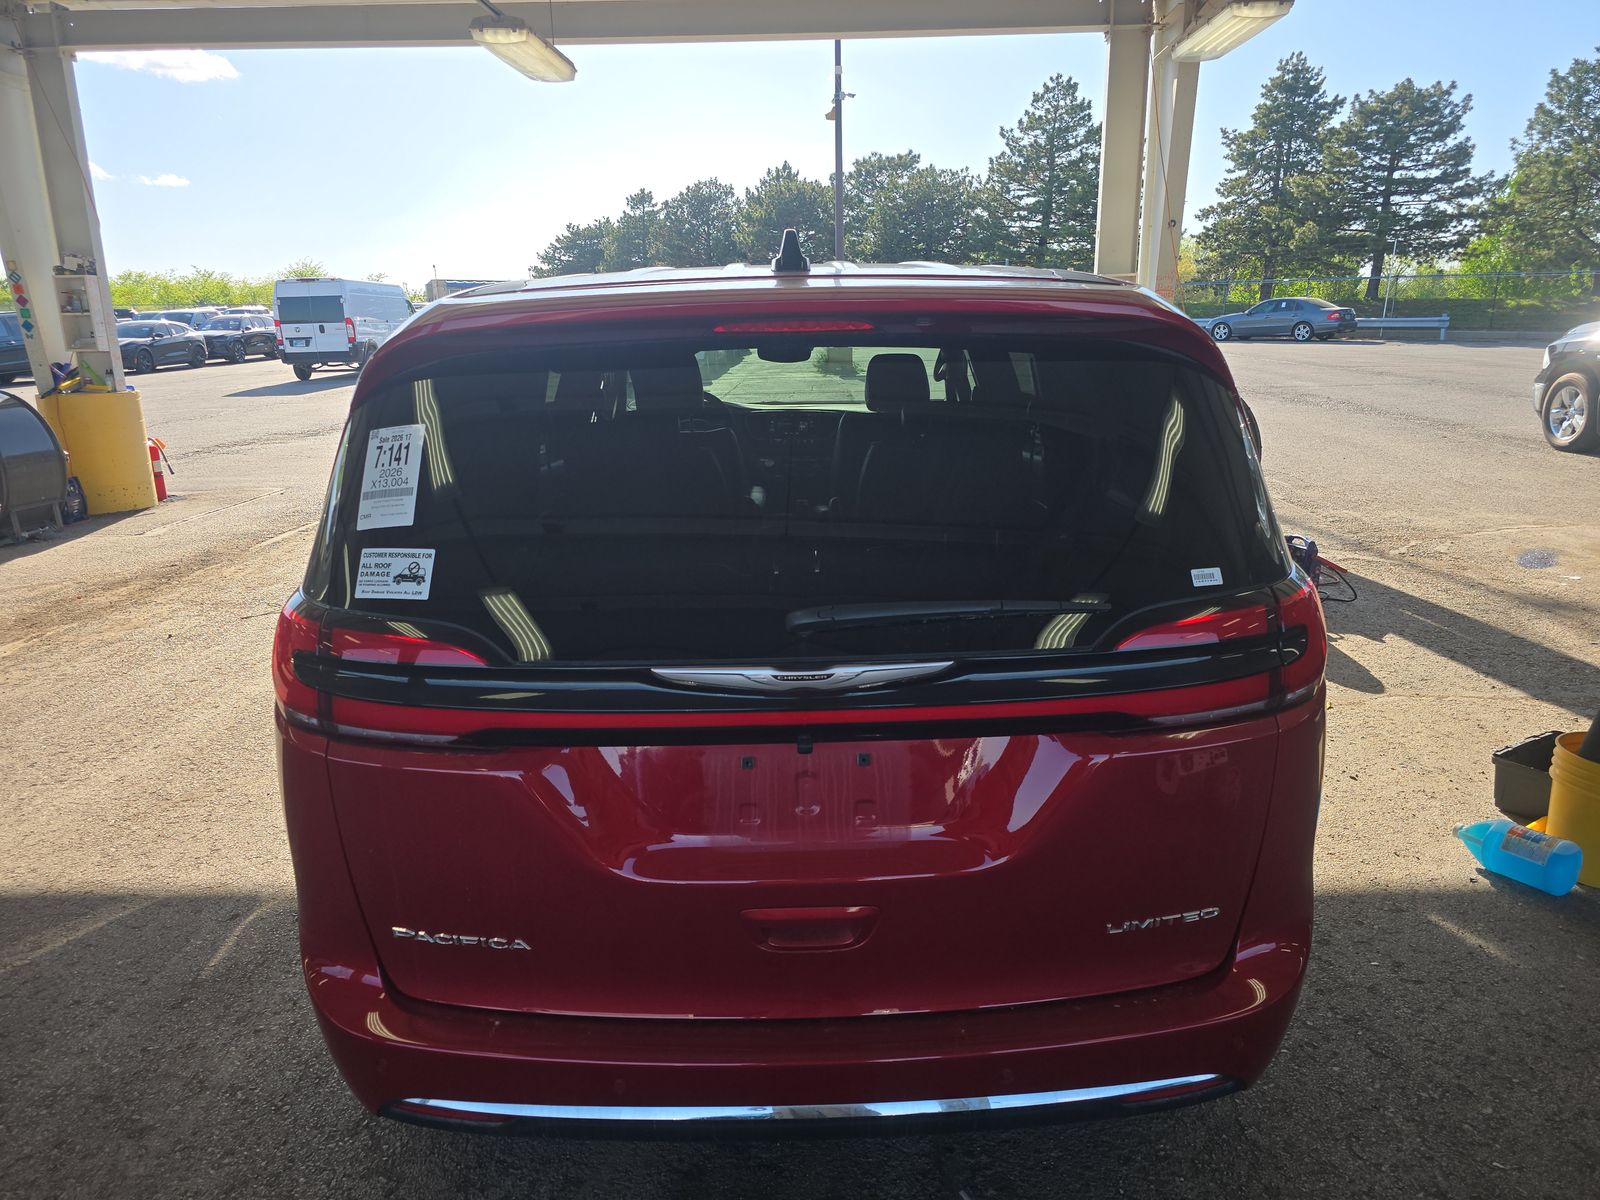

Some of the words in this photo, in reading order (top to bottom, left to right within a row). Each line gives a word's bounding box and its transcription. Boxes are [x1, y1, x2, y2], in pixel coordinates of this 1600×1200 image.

[378, 467, 403, 479] 2026
[388, 552, 421, 560] RESPONSIBLE
[1106, 907, 1221, 934] LIMITED
[391, 926, 532, 951] PACIFICA
